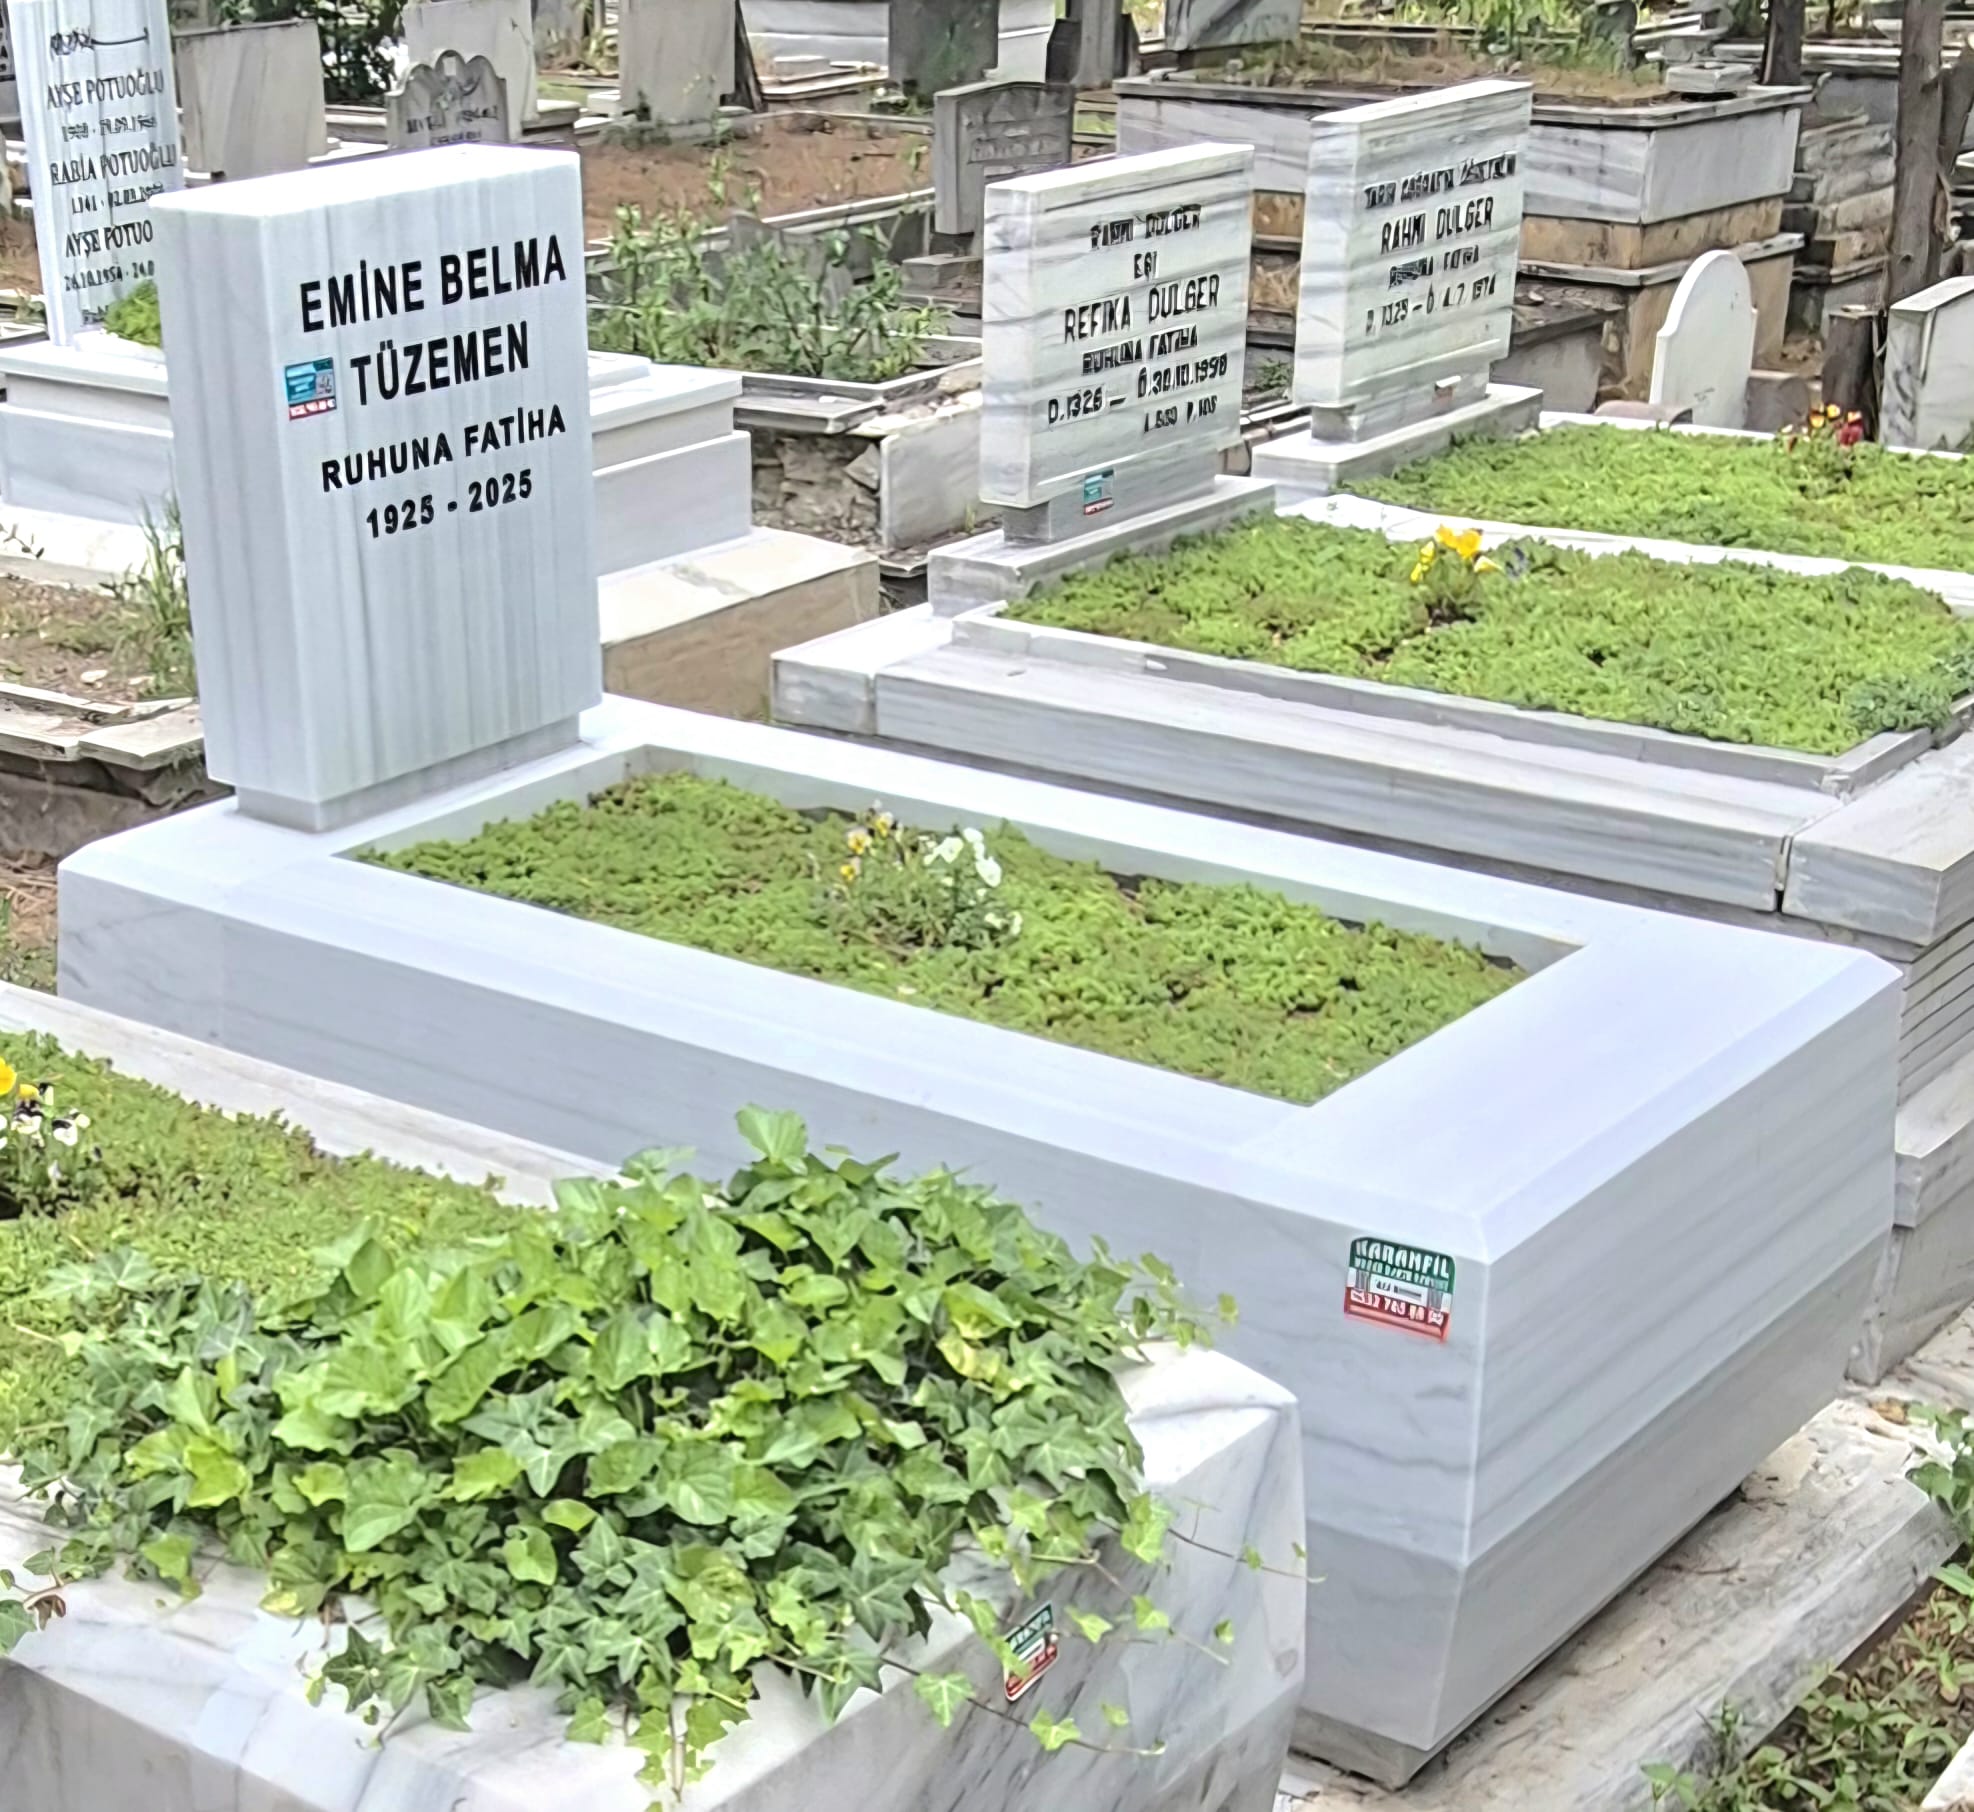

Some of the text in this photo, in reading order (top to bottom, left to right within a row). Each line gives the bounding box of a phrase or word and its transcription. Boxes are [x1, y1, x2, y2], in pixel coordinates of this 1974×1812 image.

[104, 219, 154, 251] POTUO
[300, 234, 567, 333] EMİNE BELMA
[350, 320, 529, 406] TÜZEMEN
[321, 403, 566, 492] RUHUNA FATİHA
[366, 494, 435, 538] 1925
[468, 468, 532, 513] 2025
